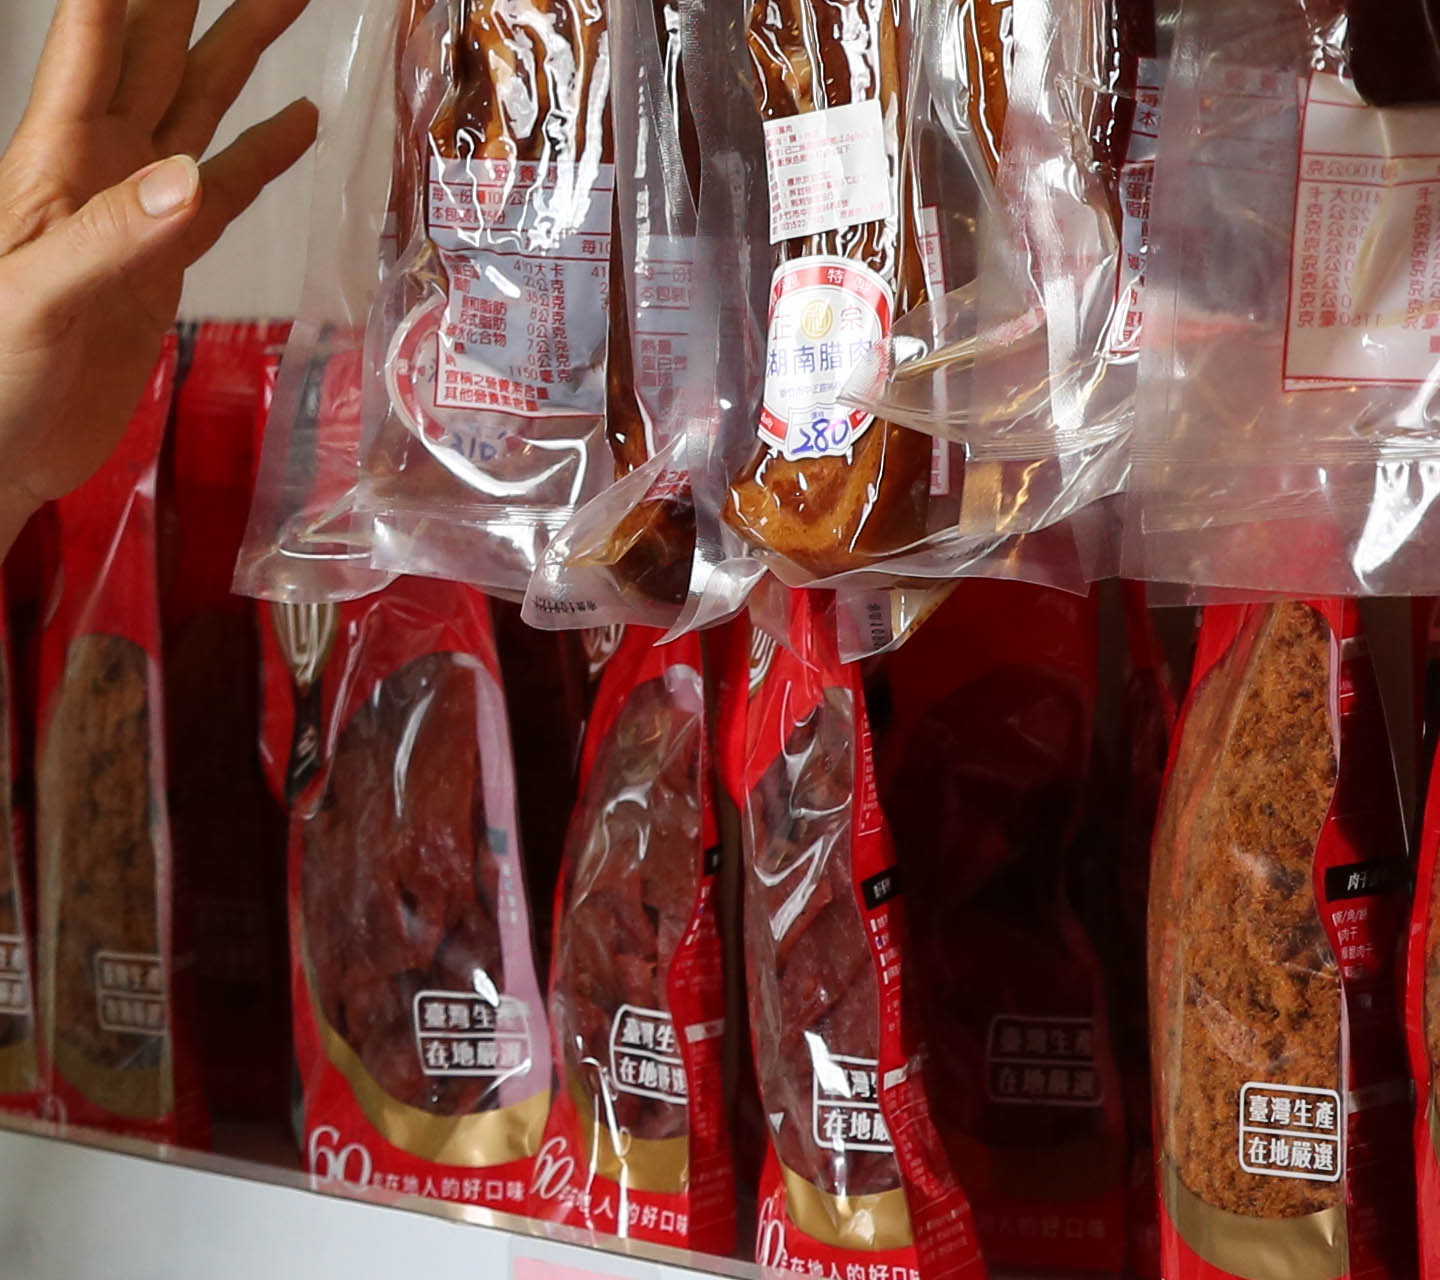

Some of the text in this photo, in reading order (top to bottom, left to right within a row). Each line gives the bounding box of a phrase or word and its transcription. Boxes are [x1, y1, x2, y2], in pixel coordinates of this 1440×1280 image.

[792, 418, 849, 454] 280
[1248, 1094, 1335, 1131] 臺灣生產
[1247, 1136, 1334, 1171] 在地嚴選
